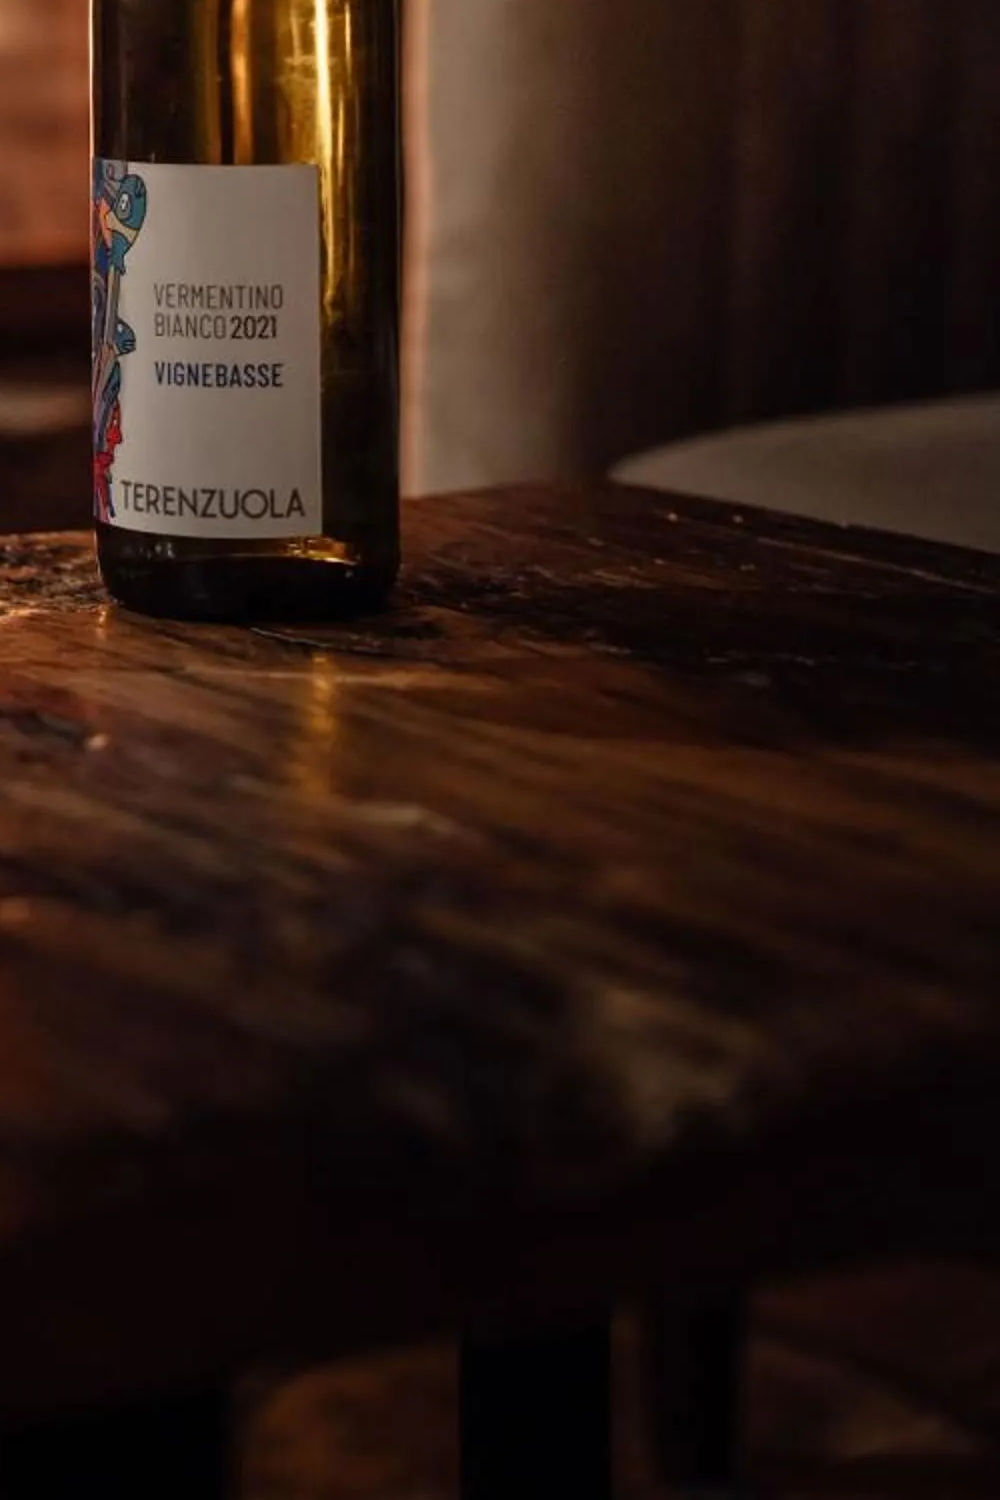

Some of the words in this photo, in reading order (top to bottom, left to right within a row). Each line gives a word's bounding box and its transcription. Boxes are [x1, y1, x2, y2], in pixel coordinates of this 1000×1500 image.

[153, 283, 284, 310] VERMENTINO
[154, 314, 227, 340] BIANCO
[230, 315, 277, 340] 2021
[154, 361, 284, 388] VIGNEBASSE
[120, 480, 306, 519] TERENZUOLA
